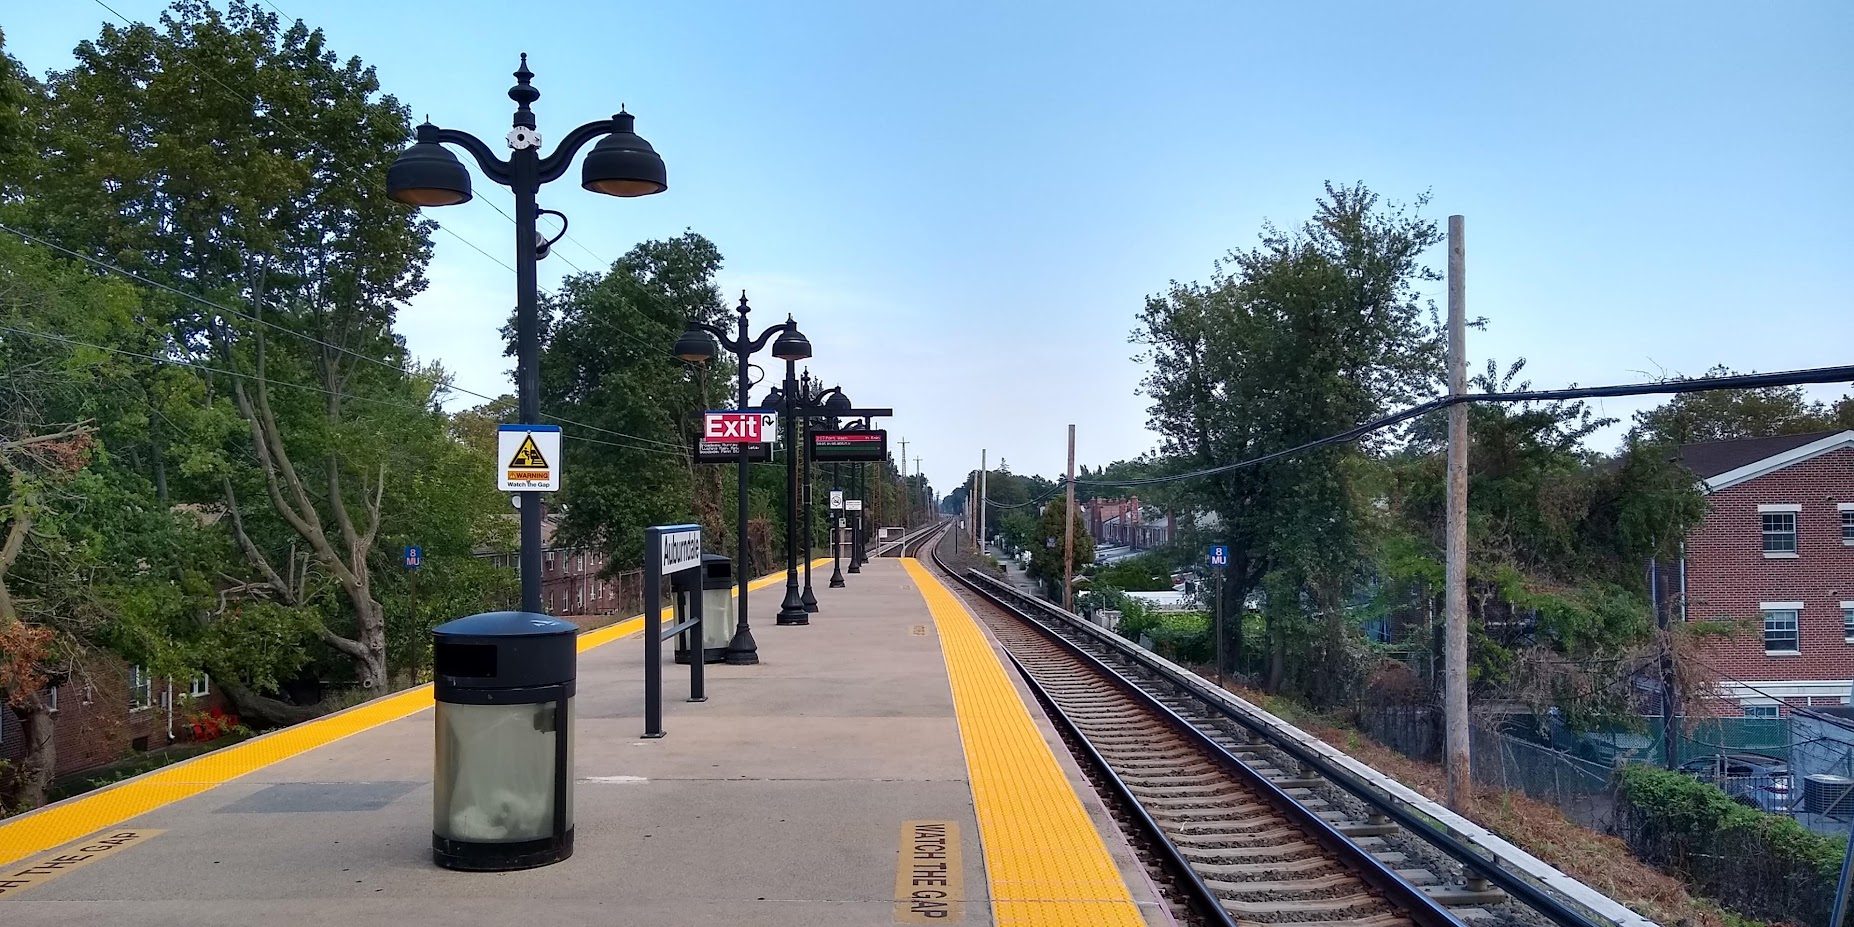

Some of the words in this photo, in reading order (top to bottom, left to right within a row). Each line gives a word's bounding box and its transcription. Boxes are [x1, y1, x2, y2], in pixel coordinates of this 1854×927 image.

[706, 415, 757, 438] Exit
[406, 557, 420, 565] MU
[410, 548, 416, 556] 8
[664, 532, 699, 567] Auburndale
[1211, 556, 1226, 564] MU
[1216, 547, 1222, 555] 8
[914, 824, 946, 859] WATCH
[13, 855, 94, 877] THE
[79, 832, 140, 852] GAP
[913, 863, 947, 886] THE
[911, 890, 948, 918] GAP
